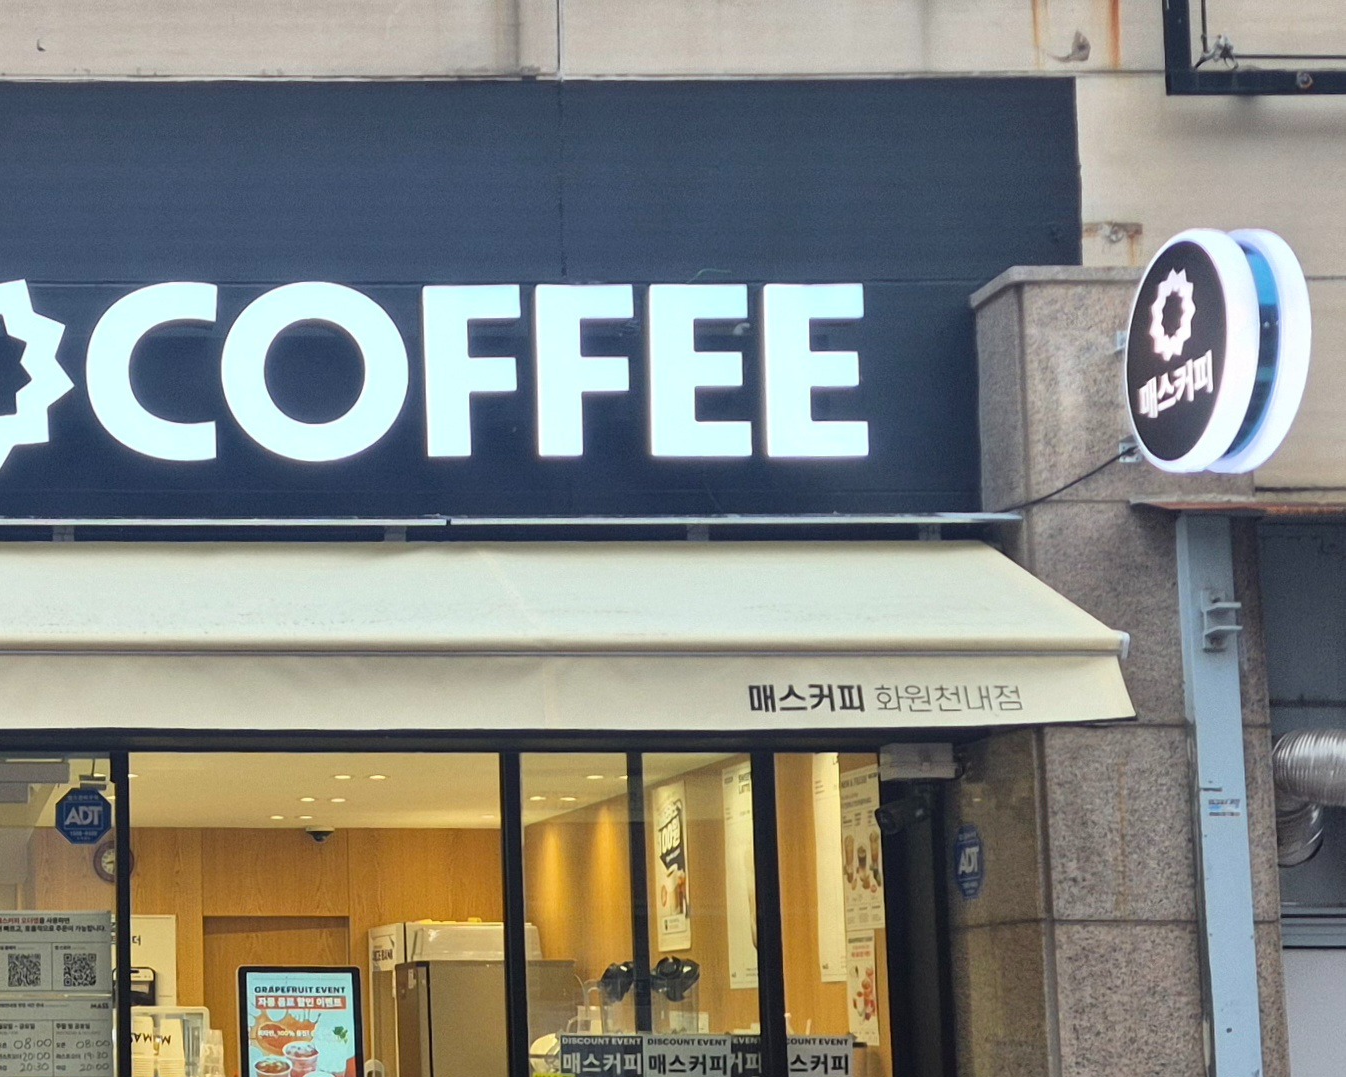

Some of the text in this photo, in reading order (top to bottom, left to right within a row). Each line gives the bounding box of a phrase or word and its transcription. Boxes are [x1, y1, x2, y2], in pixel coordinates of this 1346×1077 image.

[86, 281, 869, 462] COFFEE
[1137, 349, 1213, 418] 매스커피
[748, 684, 1024, 713] 매스커피 화원천내점
[64, 806, 103, 826] ADT
[958, 845, 980, 875] ADT
[254, 985, 346, 994] GRAPEFRUIT EVENT
[562, 1036, 641, 1045] DISCOUNT EVENT
[647, 1038, 727, 1046] DISCOUNT EVENT
[819, 1038, 848, 1046] EVENT
[562, 1052, 642, 1075] 매스커피
[648, 1053, 727, 1076] 매스커피
[789, 1053, 849, 1075] 스커피
